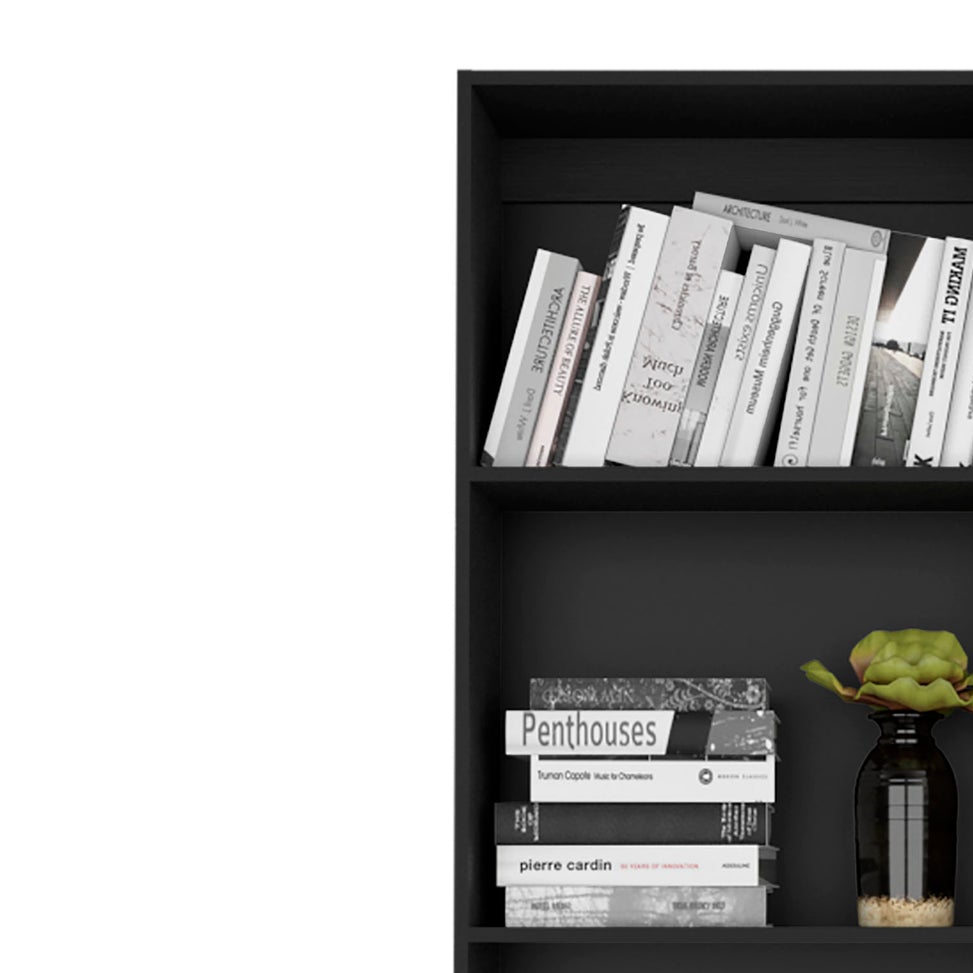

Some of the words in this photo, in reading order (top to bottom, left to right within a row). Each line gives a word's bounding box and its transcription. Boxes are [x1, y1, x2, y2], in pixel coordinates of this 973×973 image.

[521, 710, 657, 749] Penthouses
[519, 858, 562, 873] pierre
[566, 858, 612, 871] cardin
